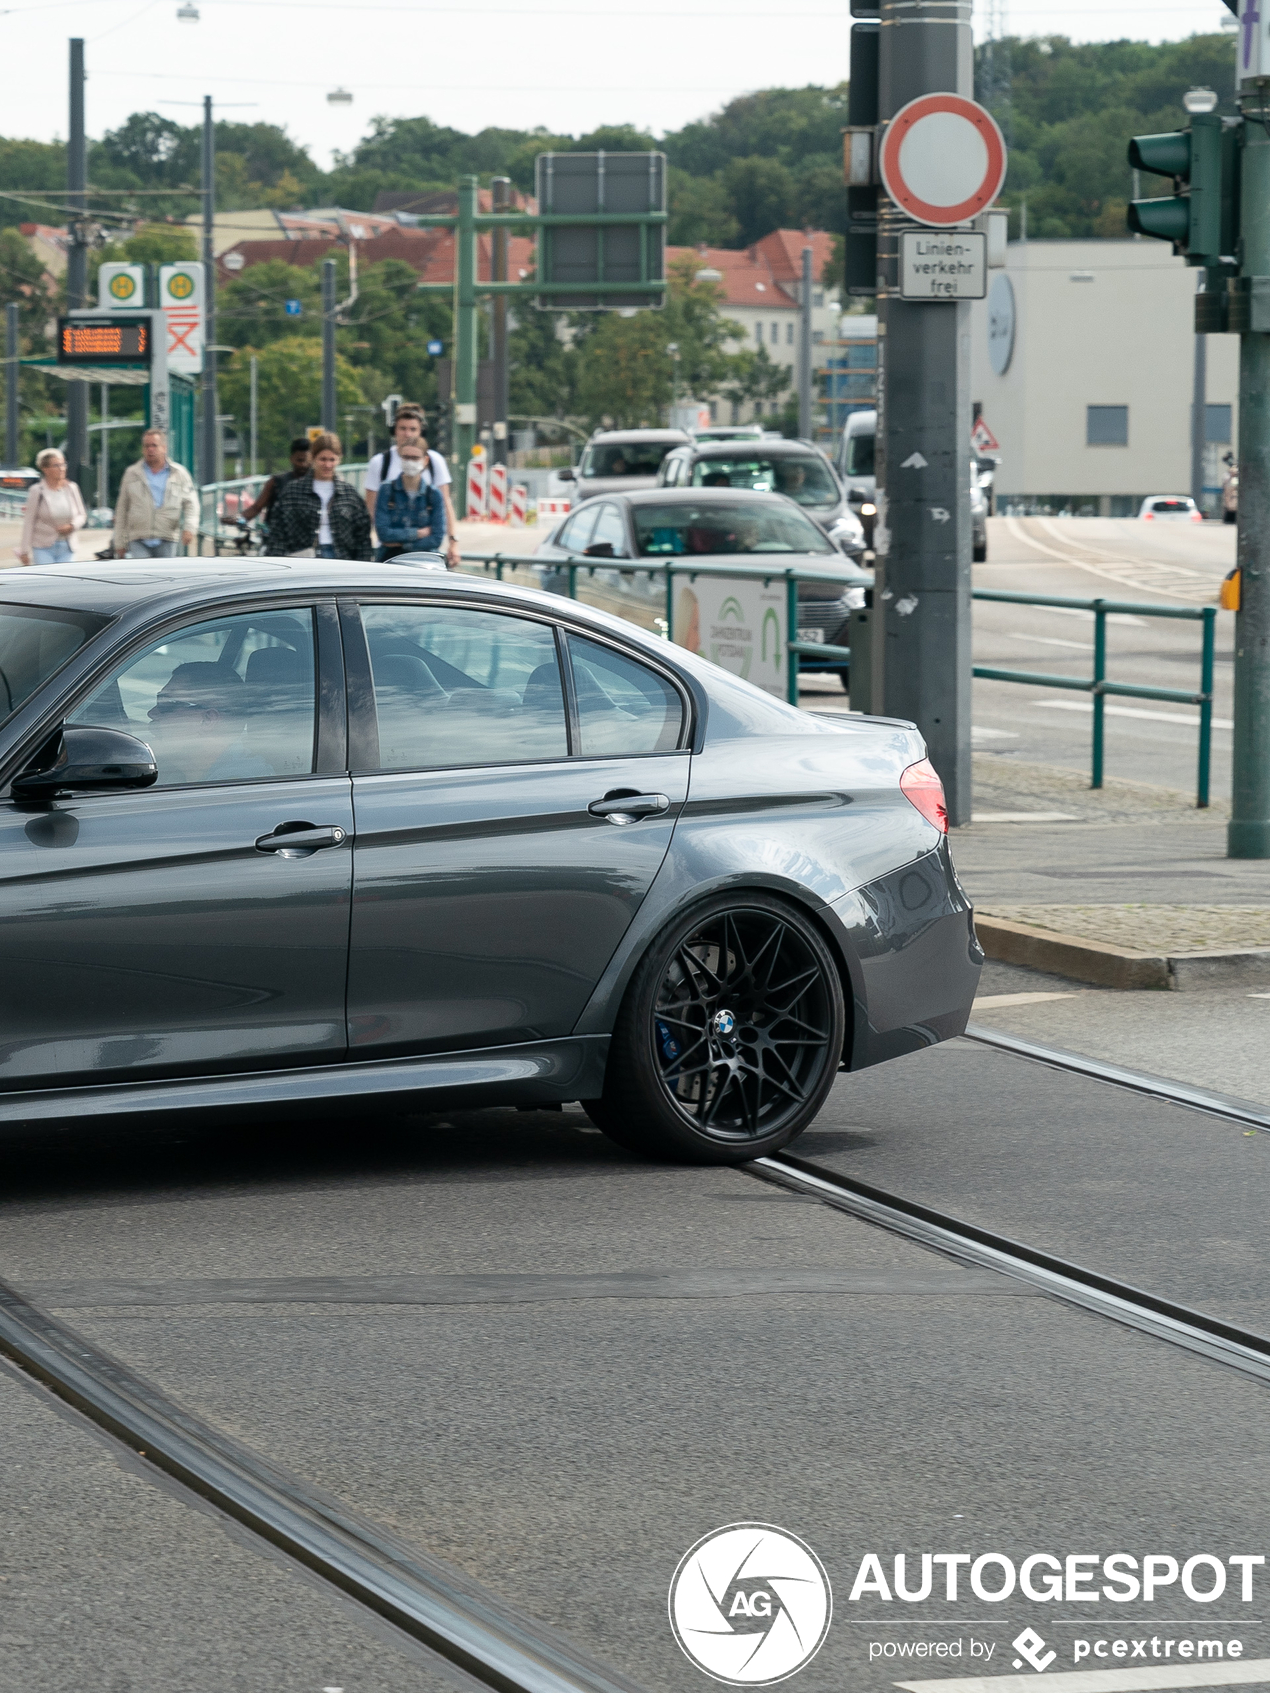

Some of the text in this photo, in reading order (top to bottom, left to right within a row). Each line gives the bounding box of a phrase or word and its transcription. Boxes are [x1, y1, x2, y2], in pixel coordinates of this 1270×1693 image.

[916, 241, 972, 255] Linien-
[913, 261, 974, 275] verkehr
[931, 279, 958, 293] frei
